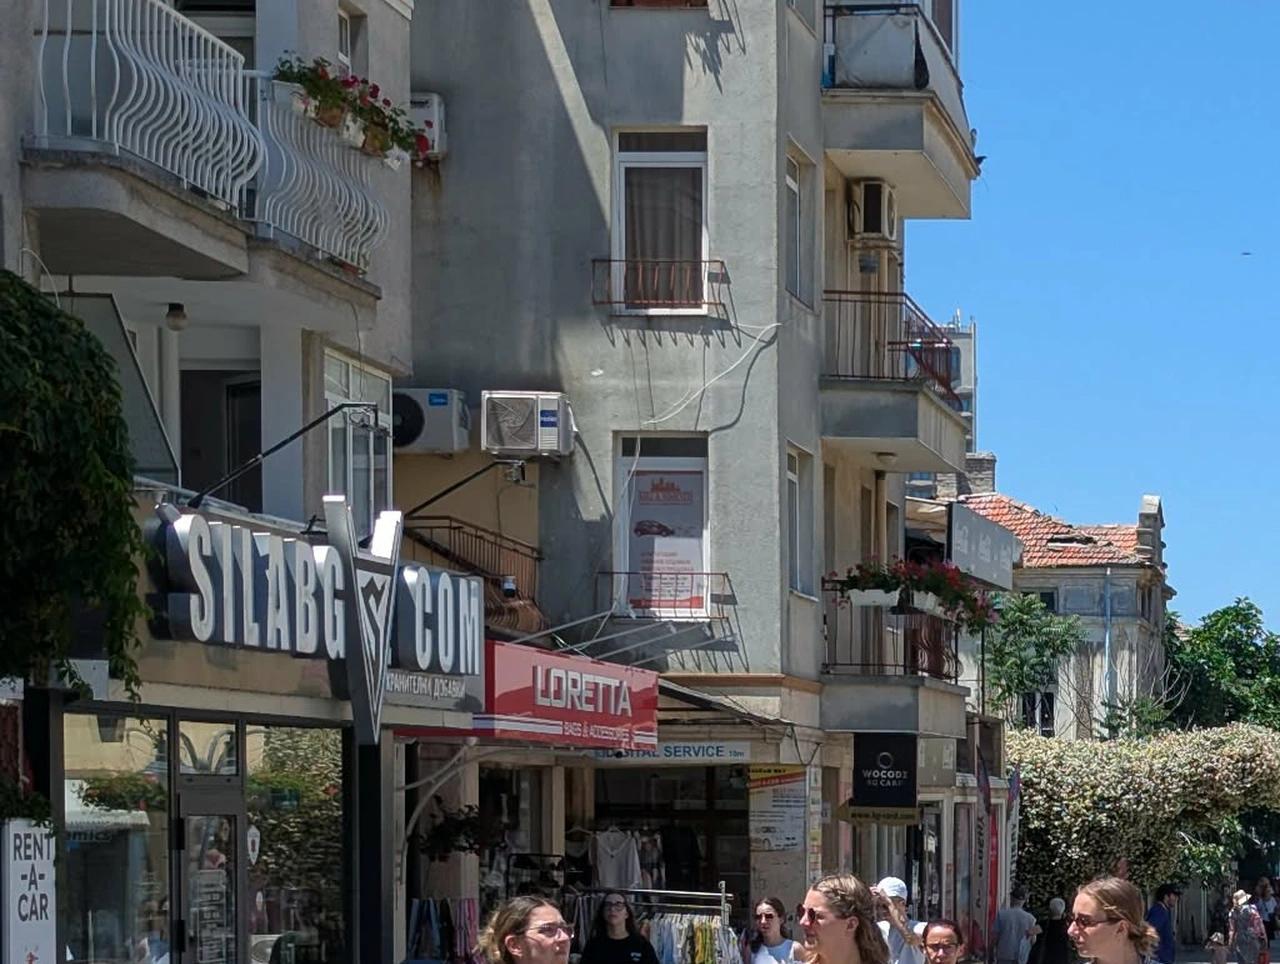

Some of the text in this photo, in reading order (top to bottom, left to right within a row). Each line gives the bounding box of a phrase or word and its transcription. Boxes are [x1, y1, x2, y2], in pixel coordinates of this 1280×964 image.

[534, 665, 633, 717] LORETTA
[664, 745, 725, 758] SERVICE
[13, 833, 52, 861] RENT
[18, 893, 49, 922] CAR
